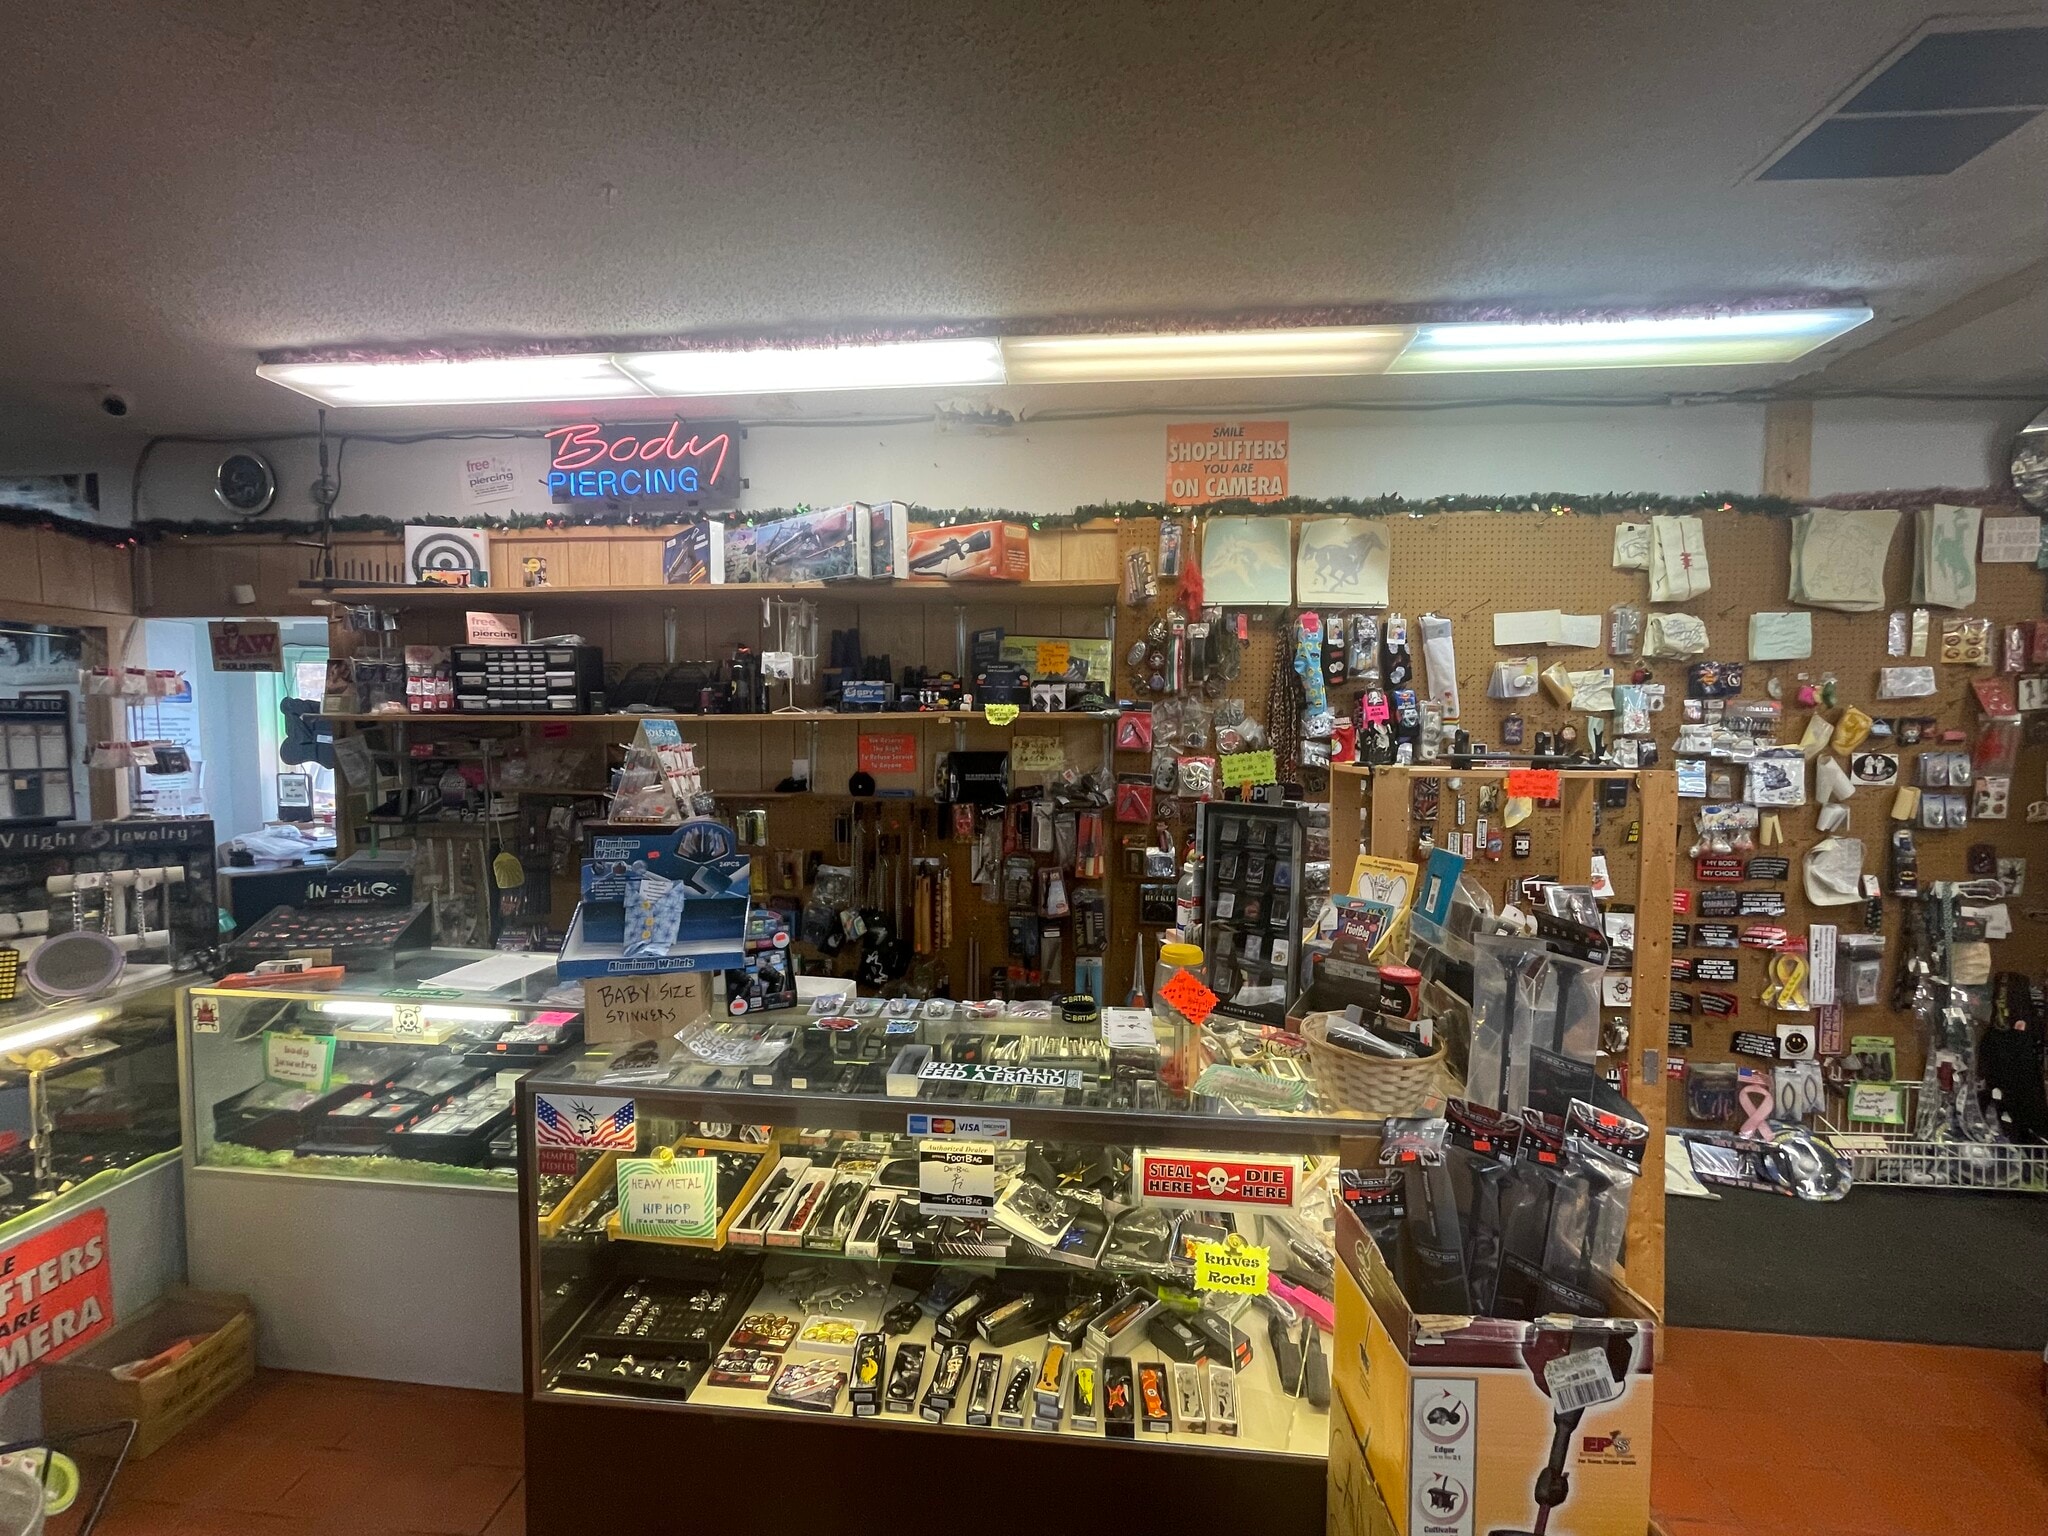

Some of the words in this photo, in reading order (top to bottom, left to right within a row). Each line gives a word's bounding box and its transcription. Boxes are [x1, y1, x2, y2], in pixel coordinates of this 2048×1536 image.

[1213, 427, 1245, 437] SMILE
[545, 421, 729, 485] Body
[1169, 440, 1286, 463] SHOPLIFTERS
[466, 460, 490, 473] free
[1203, 464, 1228, 473] YOU
[1231, 463, 1254, 473] ARE
[470, 472, 513, 487] piercing
[547, 466, 698, 497] PIERCING
[1172, 478, 1199, 498] ON
[1205, 476, 1283, 497] CAMERA
[471, 617, 497, 627] free
[473, 630, 517, 640] piercing
[214, 634, 275, 655] RAW
[221, 662, 246, 670] SOLD
[248, 662, 272, 670] HERE
[23, 833, 76, 850] light
[115, 826, 188, 845] jewelry
[595, 837, 640, 849] Aluminum
[594, 849, 631, 859] Wallets
[607, 959, 656, 972] Aluminum
[657, 957, 695, 970] Wallets
[597, 983, 649, 1008] BABY
[660, 982, 695, 1001] SIZE
[606, 1008, 676, 1024] SPINNERS
[284, 1045, 309, 1058] body
[689, 1040, 712, 1057] GO
[274, 1057, 317, 1072] jewelry
[926, 1062, 970, 1073] BUY
[974, 1064, 1064, 1077] LOCALLY
[920, 1068, 966, 1080] FEED
[971, 1071, 992, 1080] A
[997, 1073, 1063, 1086] FRIEND
[958, 1123, 980, 1132] VISA
[542, 1151, 575, 1160] SEMPER
[927, 1145, 964, 1153] Authorized
[965, 1146, 988, 1154] Dealer
[542, 1162, 575, 1171] FIDELIS
[1149, 1163, 1193, 1179] STEAL
[1245, 1169, 1285, 1185] DIE
[632, 1178, 663, 1190] HEAVY
[666, 1177, 701, 1190] METAL
[1148, 1180, 1193, 1194] HERE
[1242, 1185, 1287, 1200] HERE
[643, 1203, 662, 1214] HIP
[666, 1203, 690, 1214] HOP
[1205, 1252, 1260, 1268] knives
[1207, 1270, 1256, 1286] Rock!
[1434, 1445, 1455, 1455] Edger
